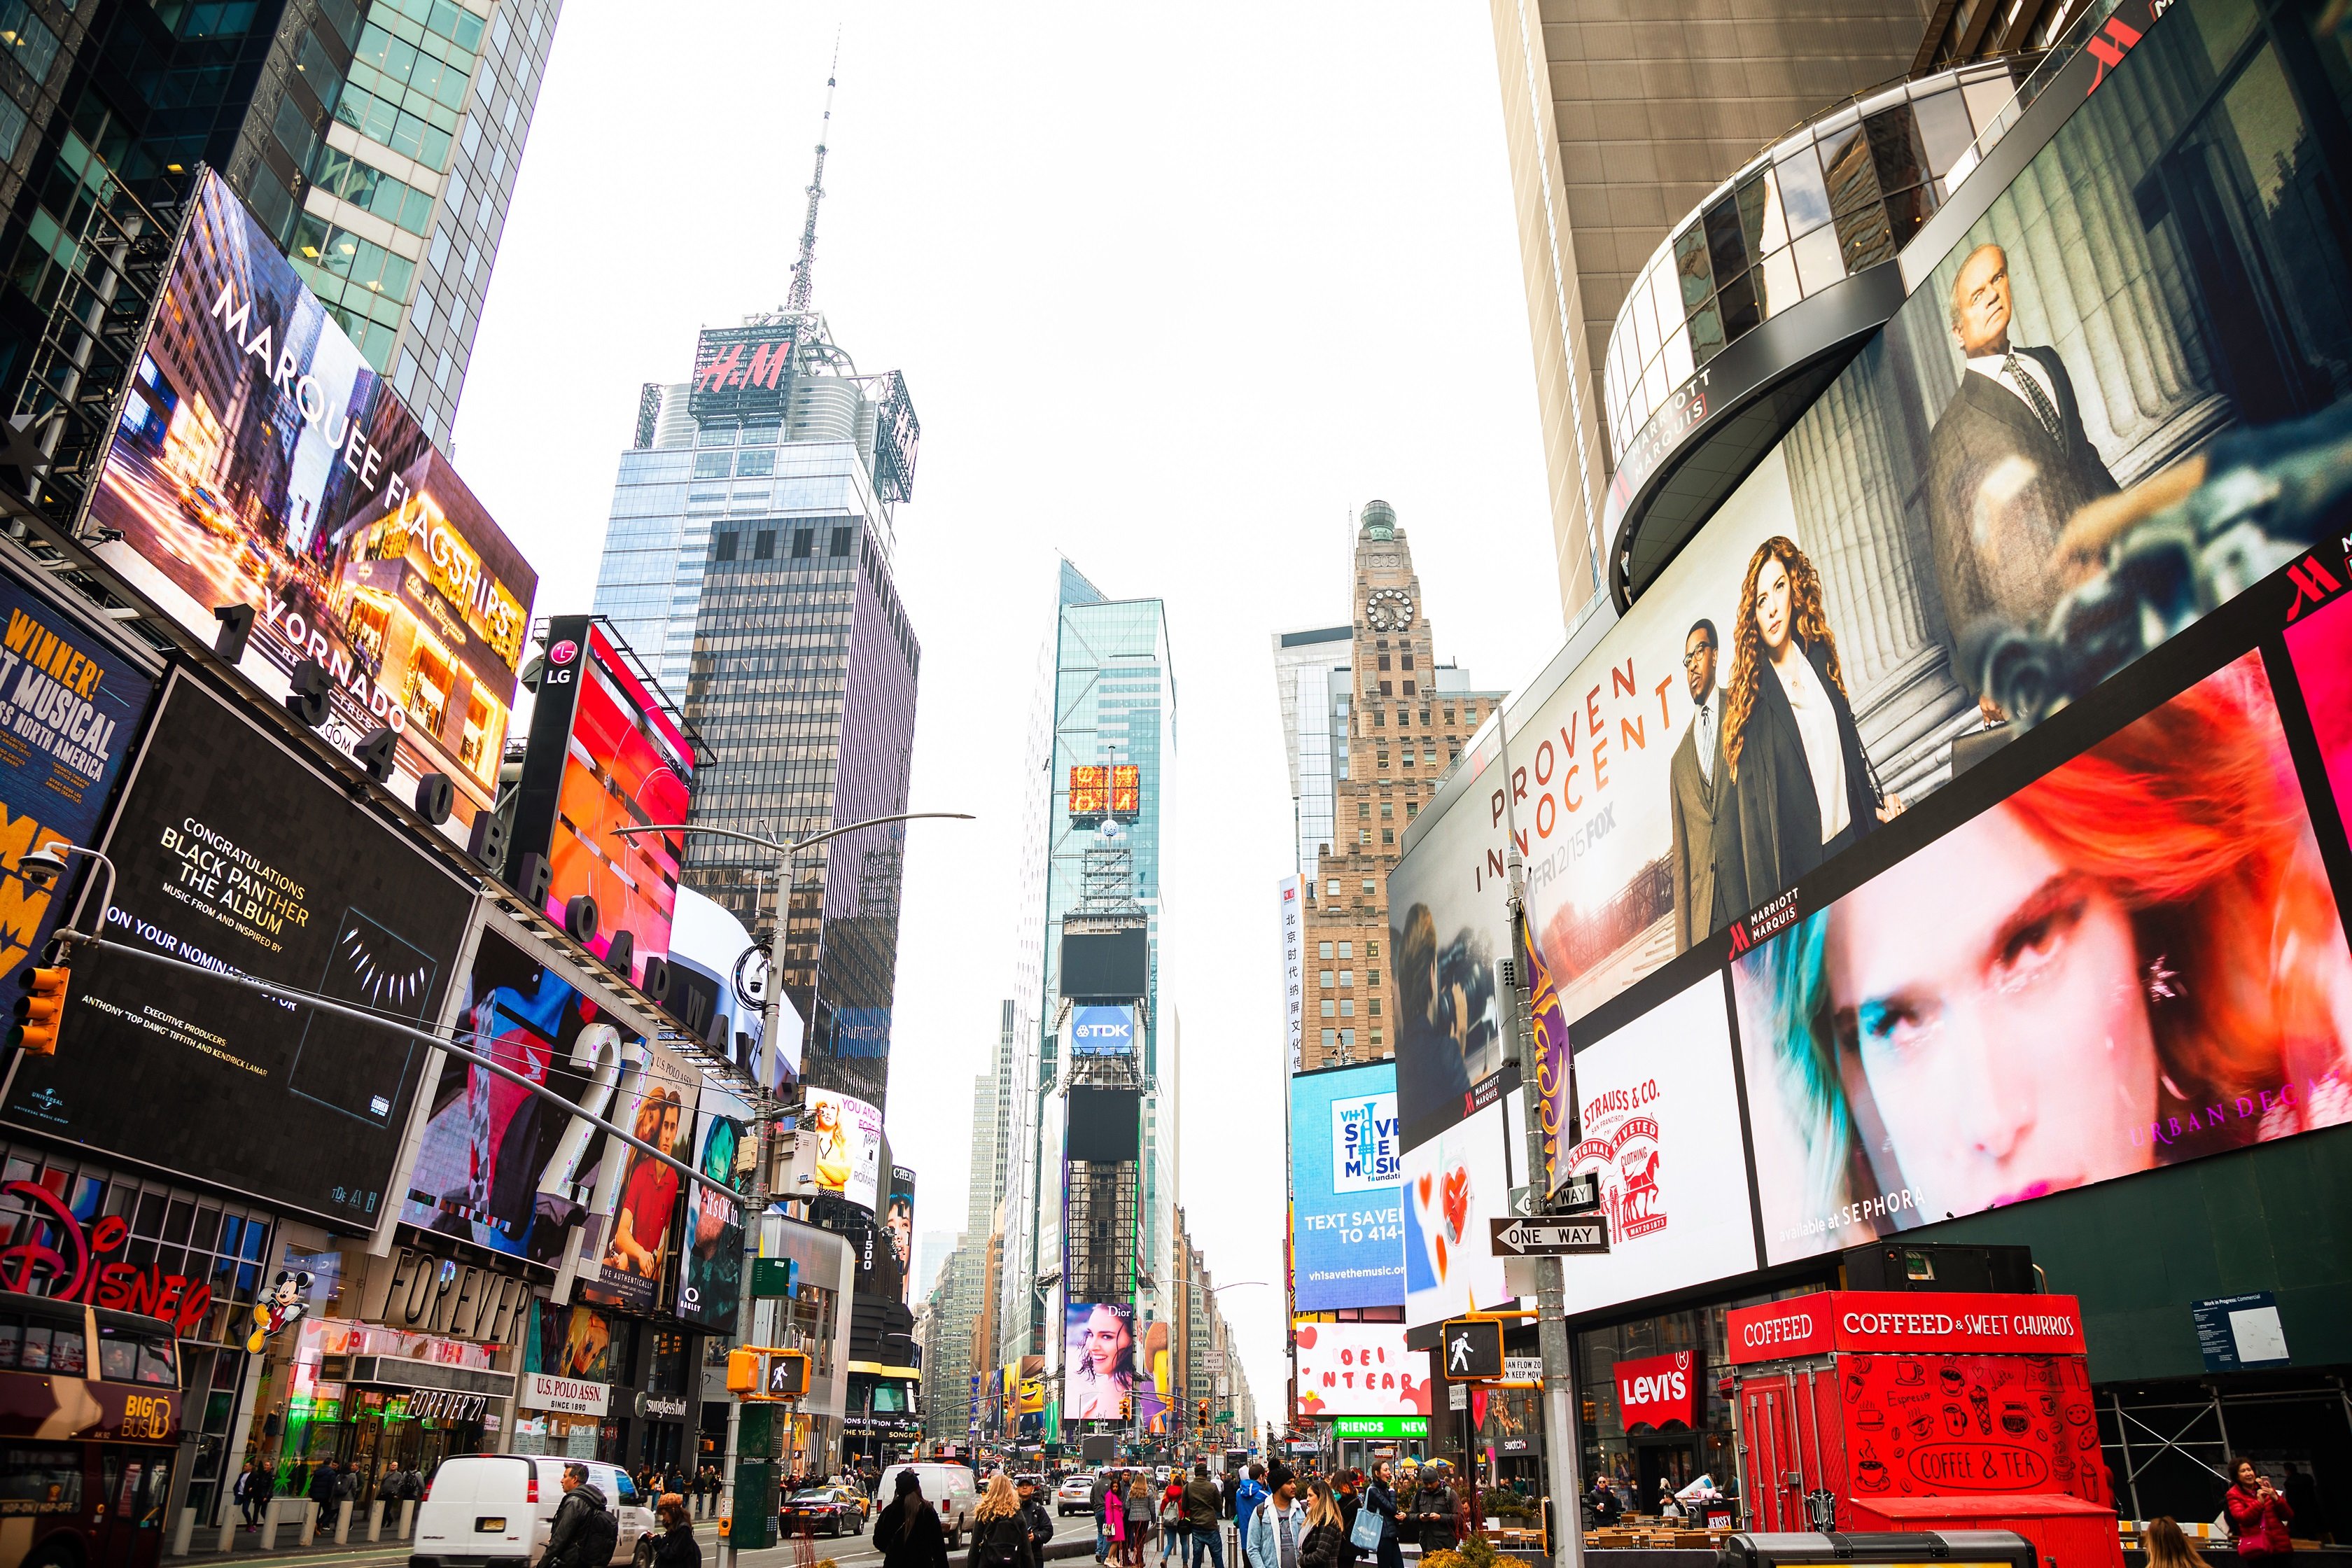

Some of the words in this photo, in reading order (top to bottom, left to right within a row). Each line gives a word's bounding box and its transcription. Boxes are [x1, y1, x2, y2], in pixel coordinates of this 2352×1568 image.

[698, 342, 791, 393] H&M
[211, 281, 382, 492] MARQUEE
[383, 471, 511, 637] FLAGSHIPS
[4, 608, 104, 701] WINNER!
[263, 586, 406, 734] VORNADO
[547, 669, 570, 684] LG
[12, 666, 115, 761] MUSICAL
[13, 713, 55, 751] NORTH
[52, 738, 104, 783] AMERICA
[1491, 657, 1637, 829] PROVEN
[1476, 674, 1672, 892] INNOCENT
[184, 817, 305, 899] CONGRATULATIONS
[1532, 854, 1556, 895] FRI
[1586, 801, 1617, 848] FOX
[161, 827, 227, 878] BLACK
[227, 867, 309, 927] PANTHER
[181, 861, 219, 898] THE
[220, 889, 284, 934] ALBUM
[1751, 887, 1799, 926] MARRIOTT
[106, 906, 132, 929] ON
[136, 919, 178, 951] YOUR
[162, 882, 190, 903] MUSIC
[191, 898, 216, 917] FROM
[216, 913, 234, 927] AND
[234, 923, 270, 946] INSPIRED
[272, 943, 282, 953] BY
[1751, 906, 1797, 941] MARQUIS
[467, 811, 755, 1072] BROADWAY
[82, 995, 123, 1016] ANTHONY
[169, 1030, 196, 1047] TIFFITH
[196, 1042, 212, 1054] AND
[213, 1049, 245, 1068] KENDRICK
[246, 1063, 267, 1077] LAMAR
[144, 1005, 184, 1029] EXECUTIVE
[184, 1022, 227, 1047] PRODUCERS:
[1088, 1024, 1129, 1037] TDK
[656, 1056, 666, 1072] U.S.
[666, 1063, 680, 1080] POLO
[31, 1092, 63, 1105] UNIVERSAL
[1475, 1074, 1499, 1098] MARRIOTT
[1475, 1087, 1497, 1107] MARQUIS
[842, 1098, 860, 1114] YOU
[862, 1105, 876, 1121] AND
[1584, 1089, 1628, 1130] STRAUSS
[1632, 1086, 1639, 1109] &
[1642, 1079, 1660, 1102] CO.
[1600, 1114, 1624, 1129] FRANCISCO
[1612, 1121, 1656, 1151] RIVETED
[2130, 1105, 2227, 1147] URBAN
[1569, 1142, 1609, 1171] ORIGINAL
[1620, 1147, 1647, 1168] CLOTHING
[706, 1190, 718, 1217] It's
[718, 1197, 729, 1222] OK
[1560, 1186, 1586, 1205] WAY
[1828, 1213, 1840, 1229] at
[1843, 1186, 1925, 1226] SEPHORA
[1305, 1213, 1347, 1231] TEXT
[1339, 1229, 1363, 1243] TO
[1509, 1229, 1542, 1244] ONE
[1558, 1228, 1592, 1242] WAY
[1630, 1226, 1642, 1236] MAY
[1649, 1219, 1665, 1231] 1873
[863, 1230, 873, 1270] 1500
[600, 1268, 611, 1278] IVE
[614, 1272, 653, 1289] AUTHENTICALLY
[383, 1247, 530, 1345] FOREVER
[680, 1300, 701, 1312] OAKLEY
[2237, 1294, 2260, 1302] Commercial
[1107, 1306, 1130, 1317] Dior
[1842, 1312, 1954, 1335] COFFEED
[1955, 1320, 1963, 1331] &
[1964, 1313, 2010, 1336] SWEET
[2013, 1315, 2075, 1337] CHURROS
[1744, 1313, 1813, 1349] COFFEED
[537, 1378, 552, 1395] U.S.
[554, 1380, 577, 1399] POLO
[578, 1385, 601, 1402] ASSN.
[1887, 1390, 1932, 1409] Espresso
[125, 1395, 152, 1418] BIG
[407, 1390, 470, 1421] FOREVER
[468, 1397, 486, 1422] 21
[551, 1400, 569, 1410] SINCE
[572, 1403, 586, 1411] 1890
[645, 1396, 674, 1419] sunglass
[675, 1398, 687, 1416] hut
[121, 1418, 149, 1437] BUS
[1504, 1439, 1523, 1450] swatch
[1921, 1451, 1976, 1480] COFFEE
[1982, 1450, 2001, 1479] &
[2005, 1452, 2037, 1478] TEA
[1708, 1516, 1730, 1529] JERSEY
